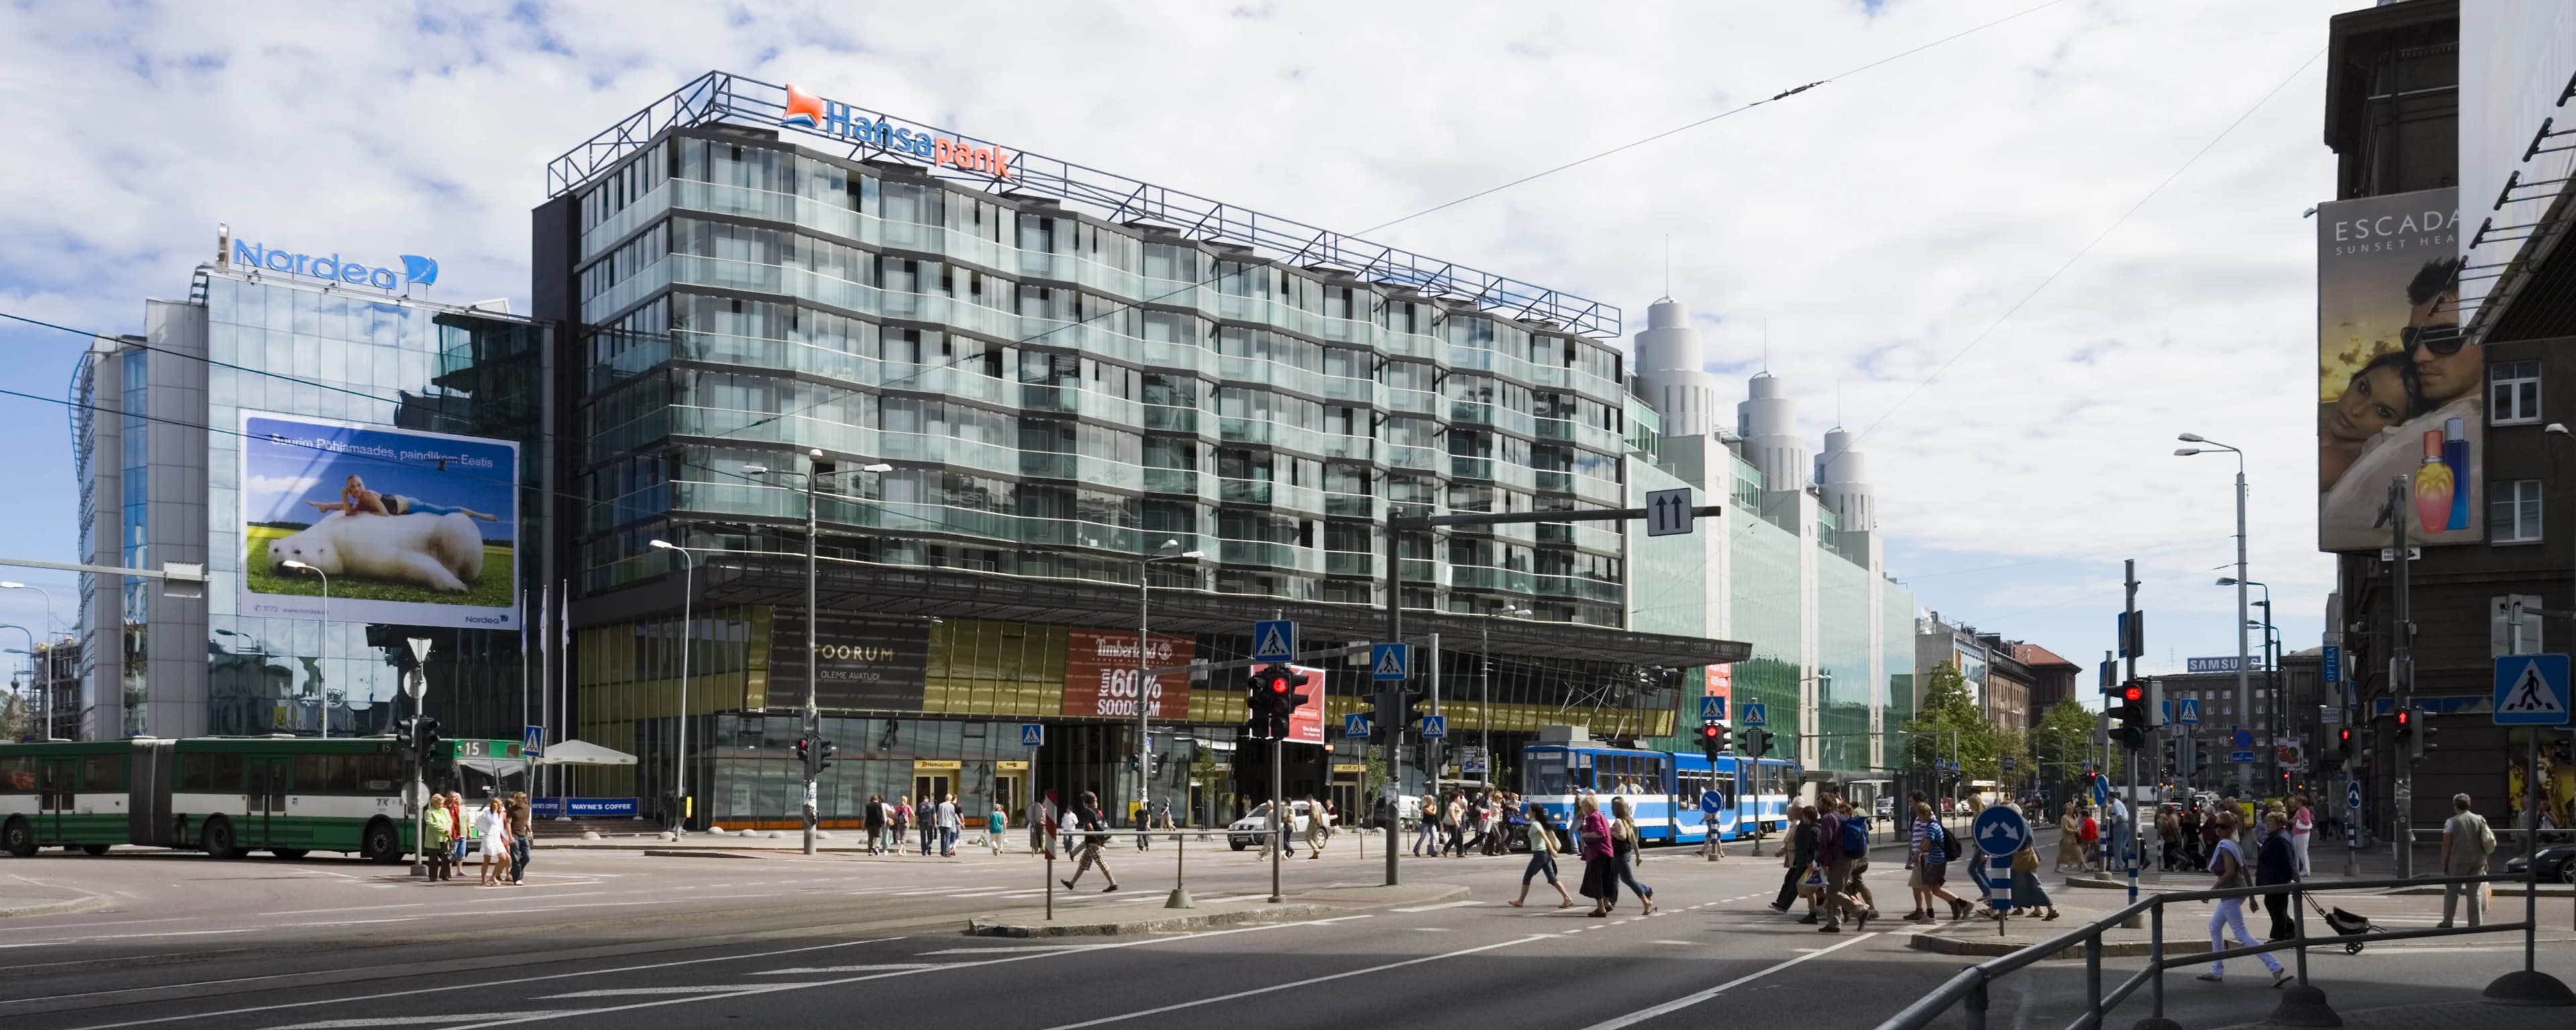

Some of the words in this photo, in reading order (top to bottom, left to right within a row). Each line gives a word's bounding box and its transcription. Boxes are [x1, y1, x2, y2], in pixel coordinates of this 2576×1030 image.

[826, 100, 1011, 178] Hansapank
[2335, 209, 2460, 242] ESCADA
[2335, 239, 2406, 256] SUNSET
[233, 237, 397, 290] Nordea
[270, 433, 313, 448] Suurim
[316, 438, 397, 459] Põhjamaades,
[461, 454, 493, 468] Eestis
[466, 616, 500, 624] Nordea
[820, 670, 847, 679] OLEME
[2189, 658, 2259, 671] SAMSUG
[2326, 646, 2335, 681] OPTIKA
[1097, 668, 1112, 697] kuni
[382, 744, 391, 752] 15
[465, 742, 480, 756] 15
